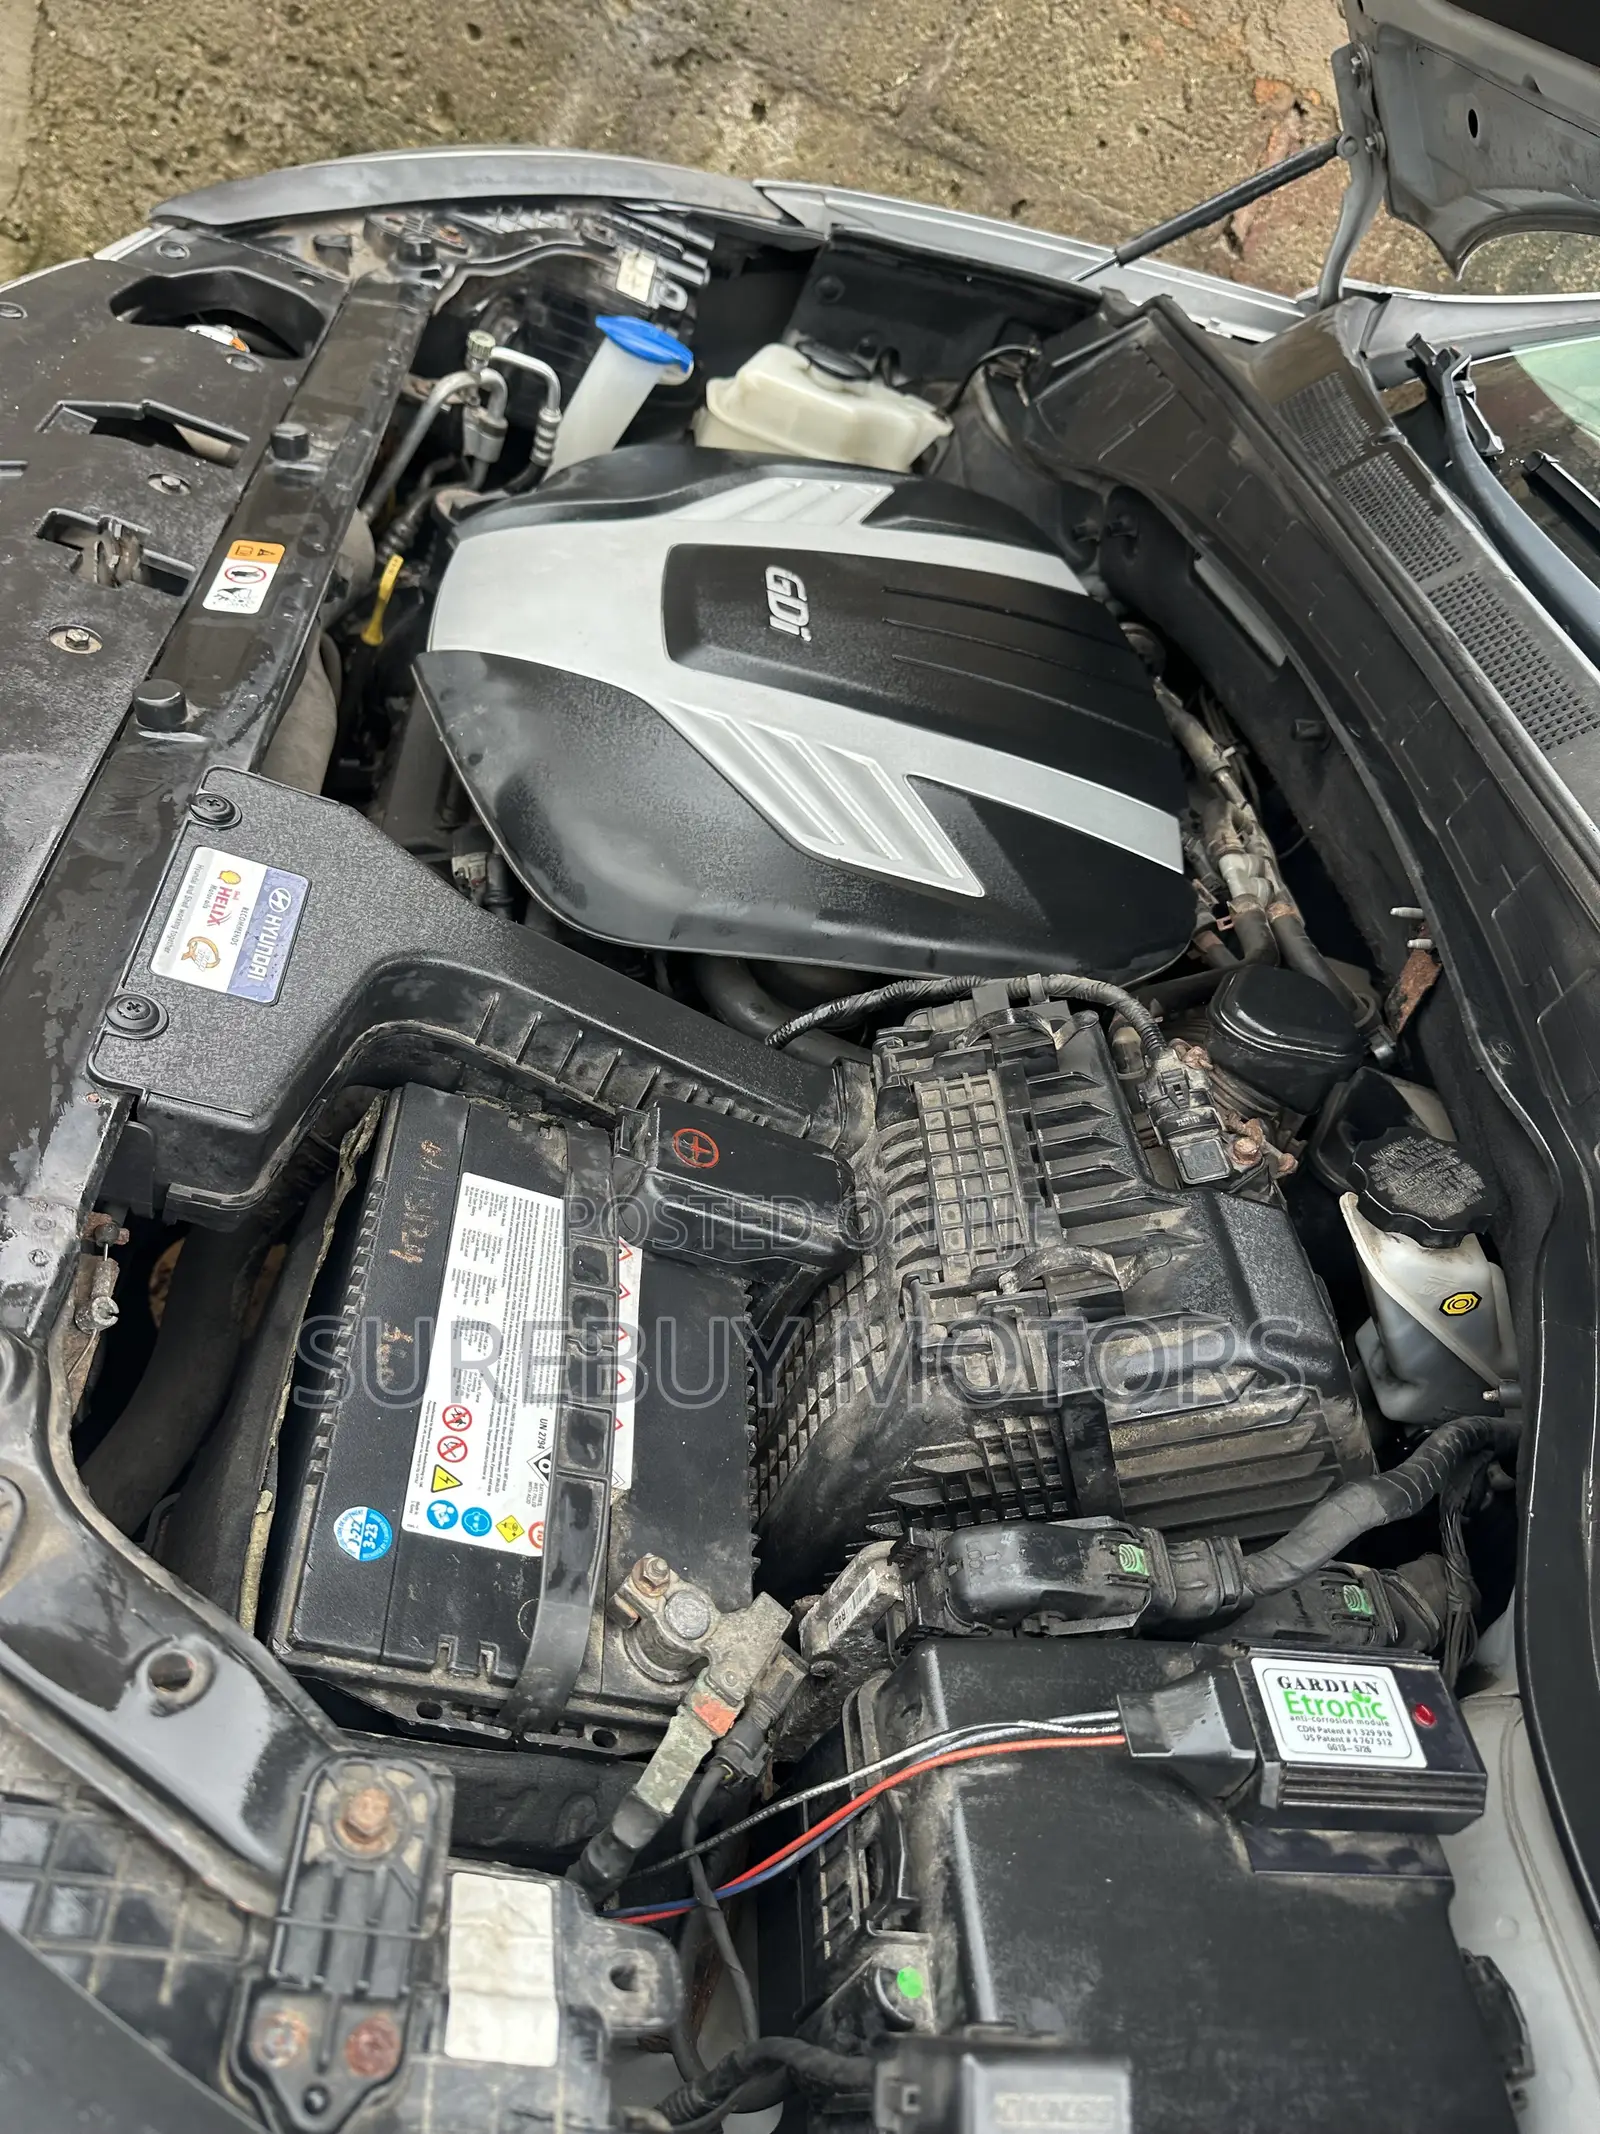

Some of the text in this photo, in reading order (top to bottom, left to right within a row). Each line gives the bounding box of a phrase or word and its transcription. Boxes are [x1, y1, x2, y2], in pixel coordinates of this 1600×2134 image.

[206, 886, 233, 927] HELIX
[230, 907, 249, 946] RECOMMENDS
[248, 914, 283, 981] HYUNDAI
[537, 1418, 549, 1450] UN 2794
[362, 1523, 379, 1550] 3-23
[1277, 1675, 1380, 1695] GARDIAN
[1282, 1689, 1388, 1720] Etronic
[1289, 1715, 1390, 1727] anti-corrosion module
[1296, 1725, 1316, 1733] CDN
[1317, 1726, 1345, 1735] Patent
[1303, 1734, 1315, 1742] US
[1316, 1735, 1345, 1743] Patent
